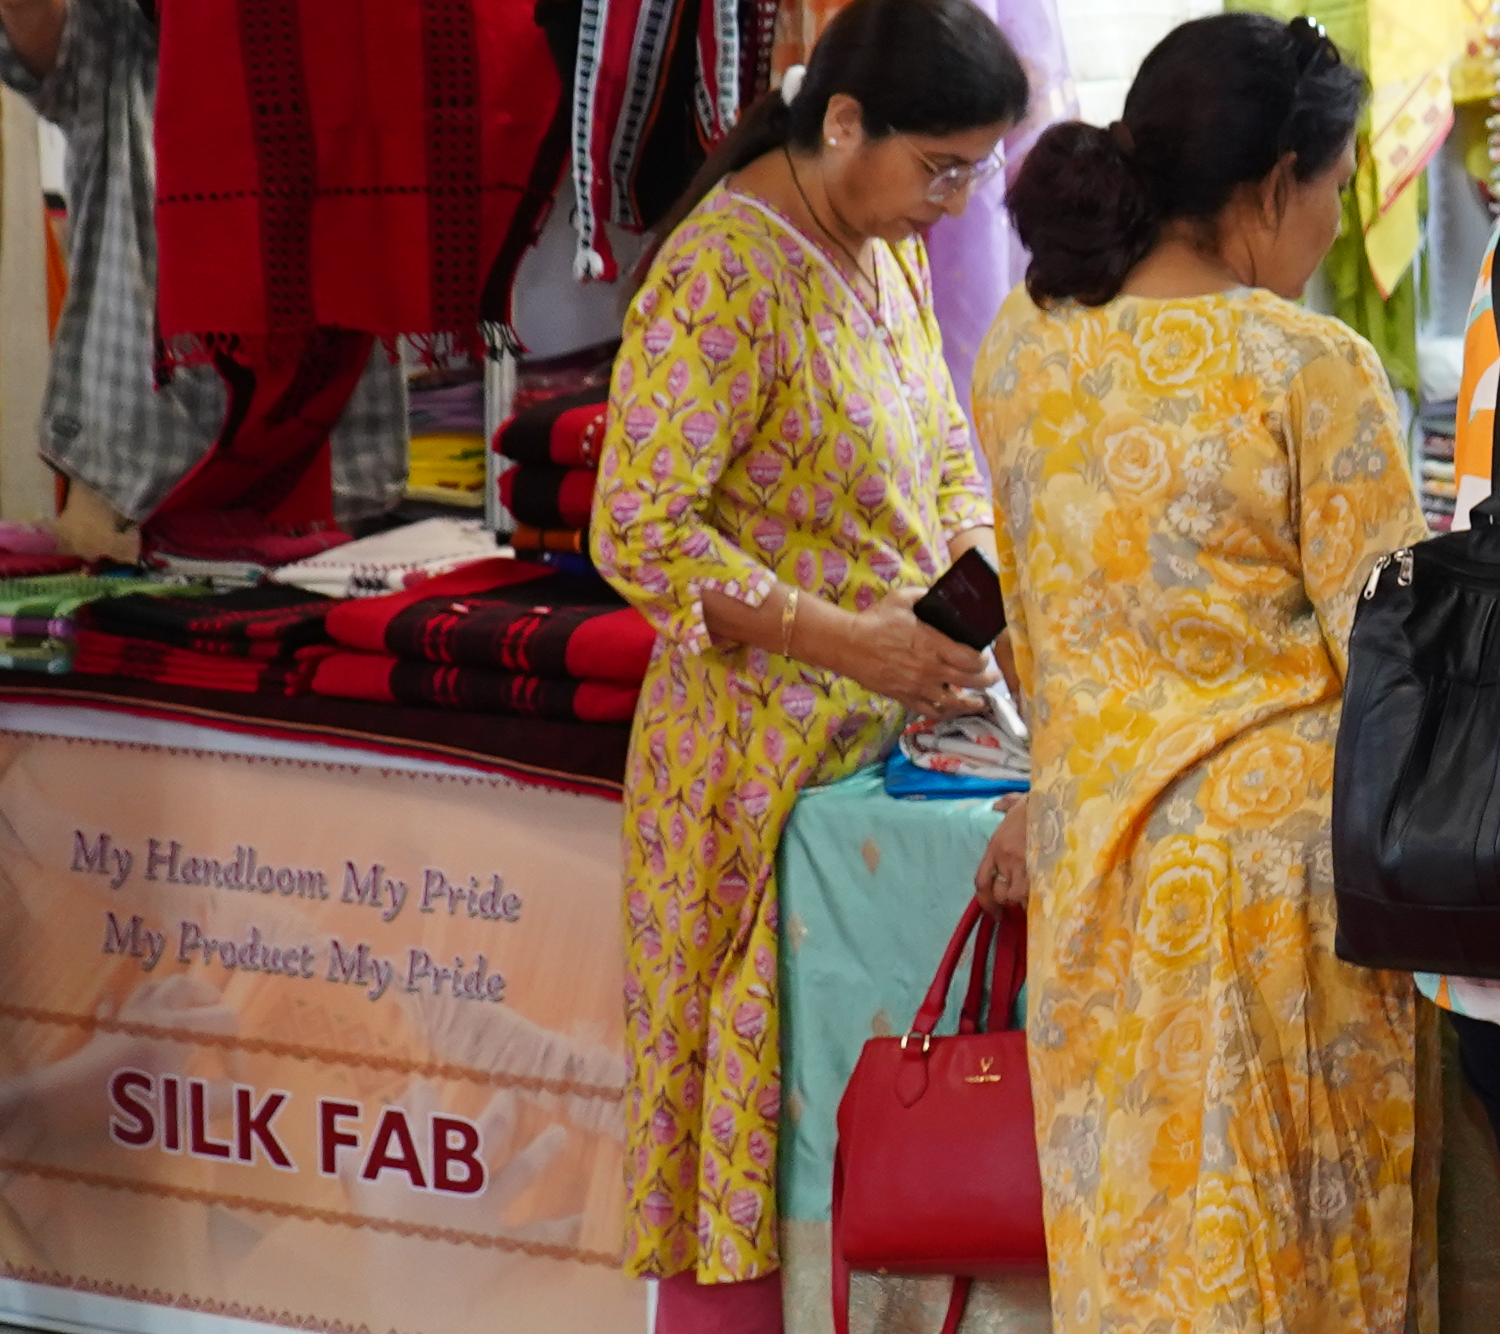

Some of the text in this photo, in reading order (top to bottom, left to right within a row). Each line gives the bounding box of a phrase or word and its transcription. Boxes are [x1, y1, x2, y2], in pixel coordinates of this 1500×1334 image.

[71, 829, 522, 923] My Handloom My Pride
[102, 910, 507, 1002] My Product My Pride
[109, 1069, 487, 1196] SILK FAB
